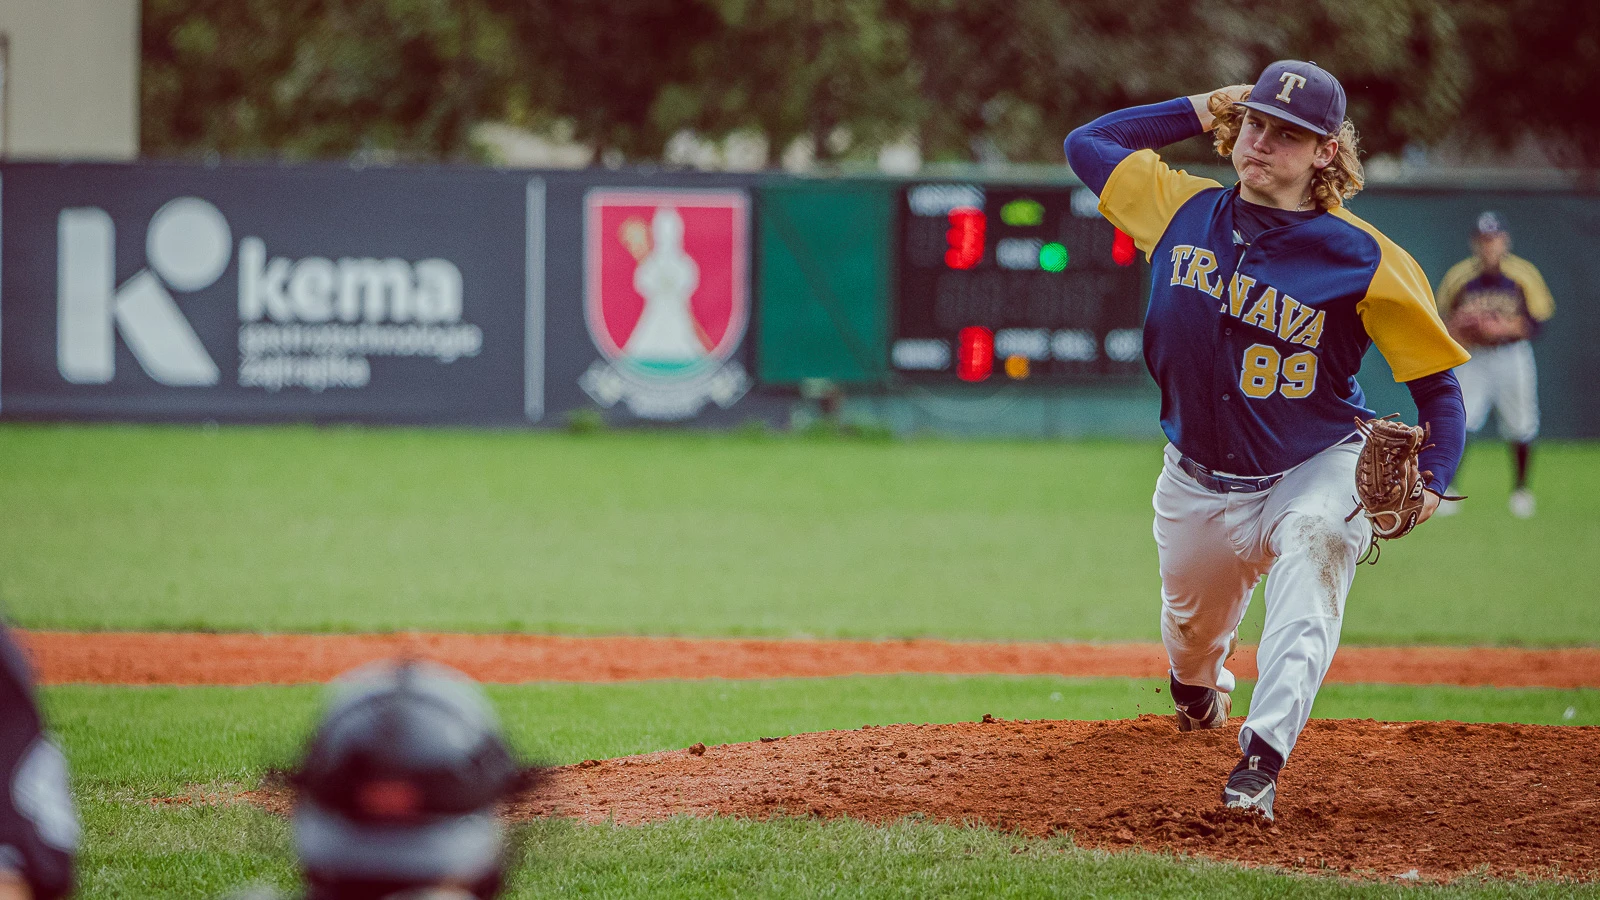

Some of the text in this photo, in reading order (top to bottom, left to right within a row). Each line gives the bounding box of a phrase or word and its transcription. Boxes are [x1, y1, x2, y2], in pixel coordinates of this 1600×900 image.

[1275, 71, 1307, 104] T
[238, 236, 464, 323] kema
[1170, 244, 1326, 349] TRNAVA
[1239, 343, 1318, 399] 89
